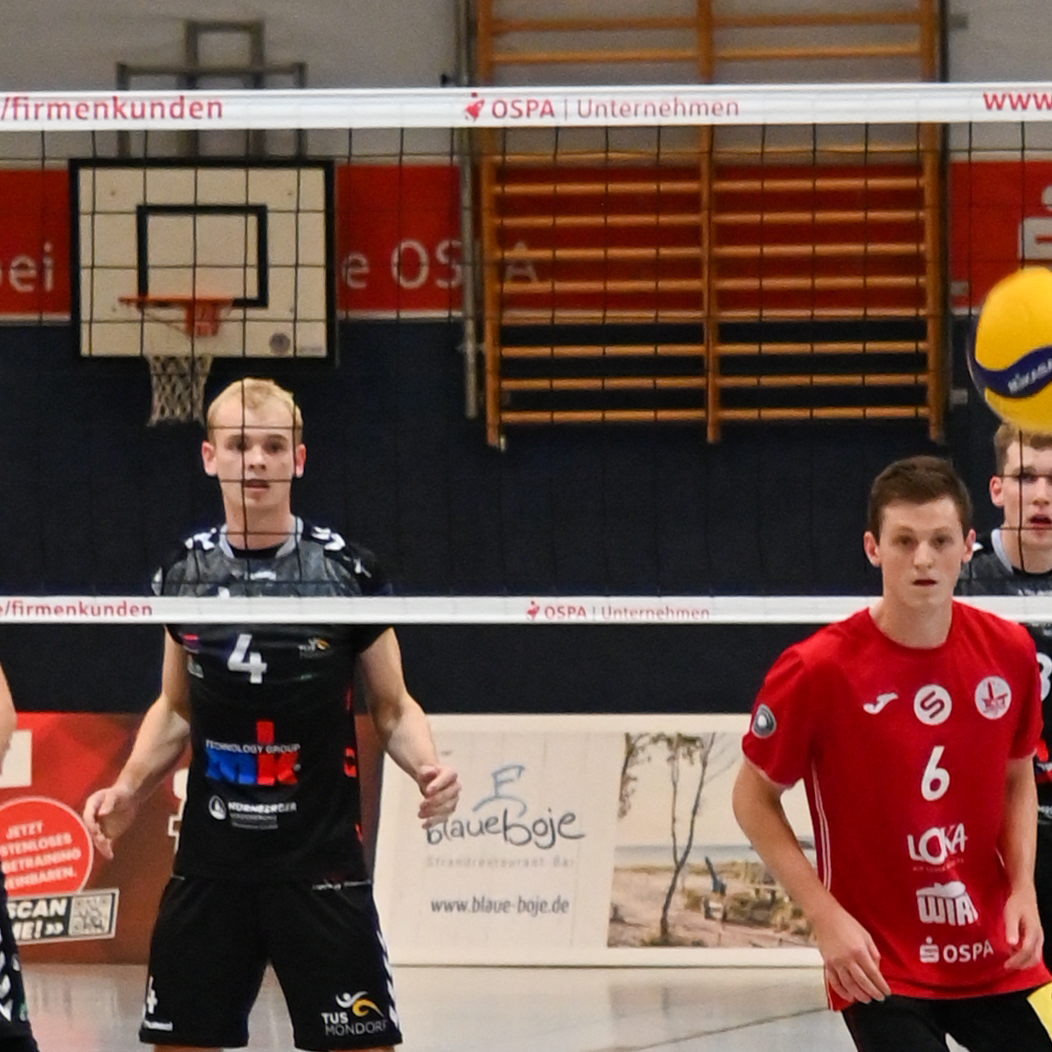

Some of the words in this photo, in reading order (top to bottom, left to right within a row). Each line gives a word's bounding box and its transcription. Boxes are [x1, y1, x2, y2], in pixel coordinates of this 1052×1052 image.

[491, 98, 556, 119] OSPA
[576, 97, 740, 119] Unternehmen
[0, 241, 55, 293] ei
[390, 239, 539, 290] OSA
[544, 605, 587, 620] OSPA
[601, 605, 710, 620] Unternehmen
[227, 633, 268, 684] 4
[921, 744, 950, 802] 6
[6, 820, 43, 840] JETZT
[907, 823, 968, 865] LOKA
[430, 894, 570, 917] www.blaue-boje.de
[943, 938, 994, 964] OSPA
[321, 1011, 349, 1025] TUS
[324, 1018, 388, 1037] MONDORF
